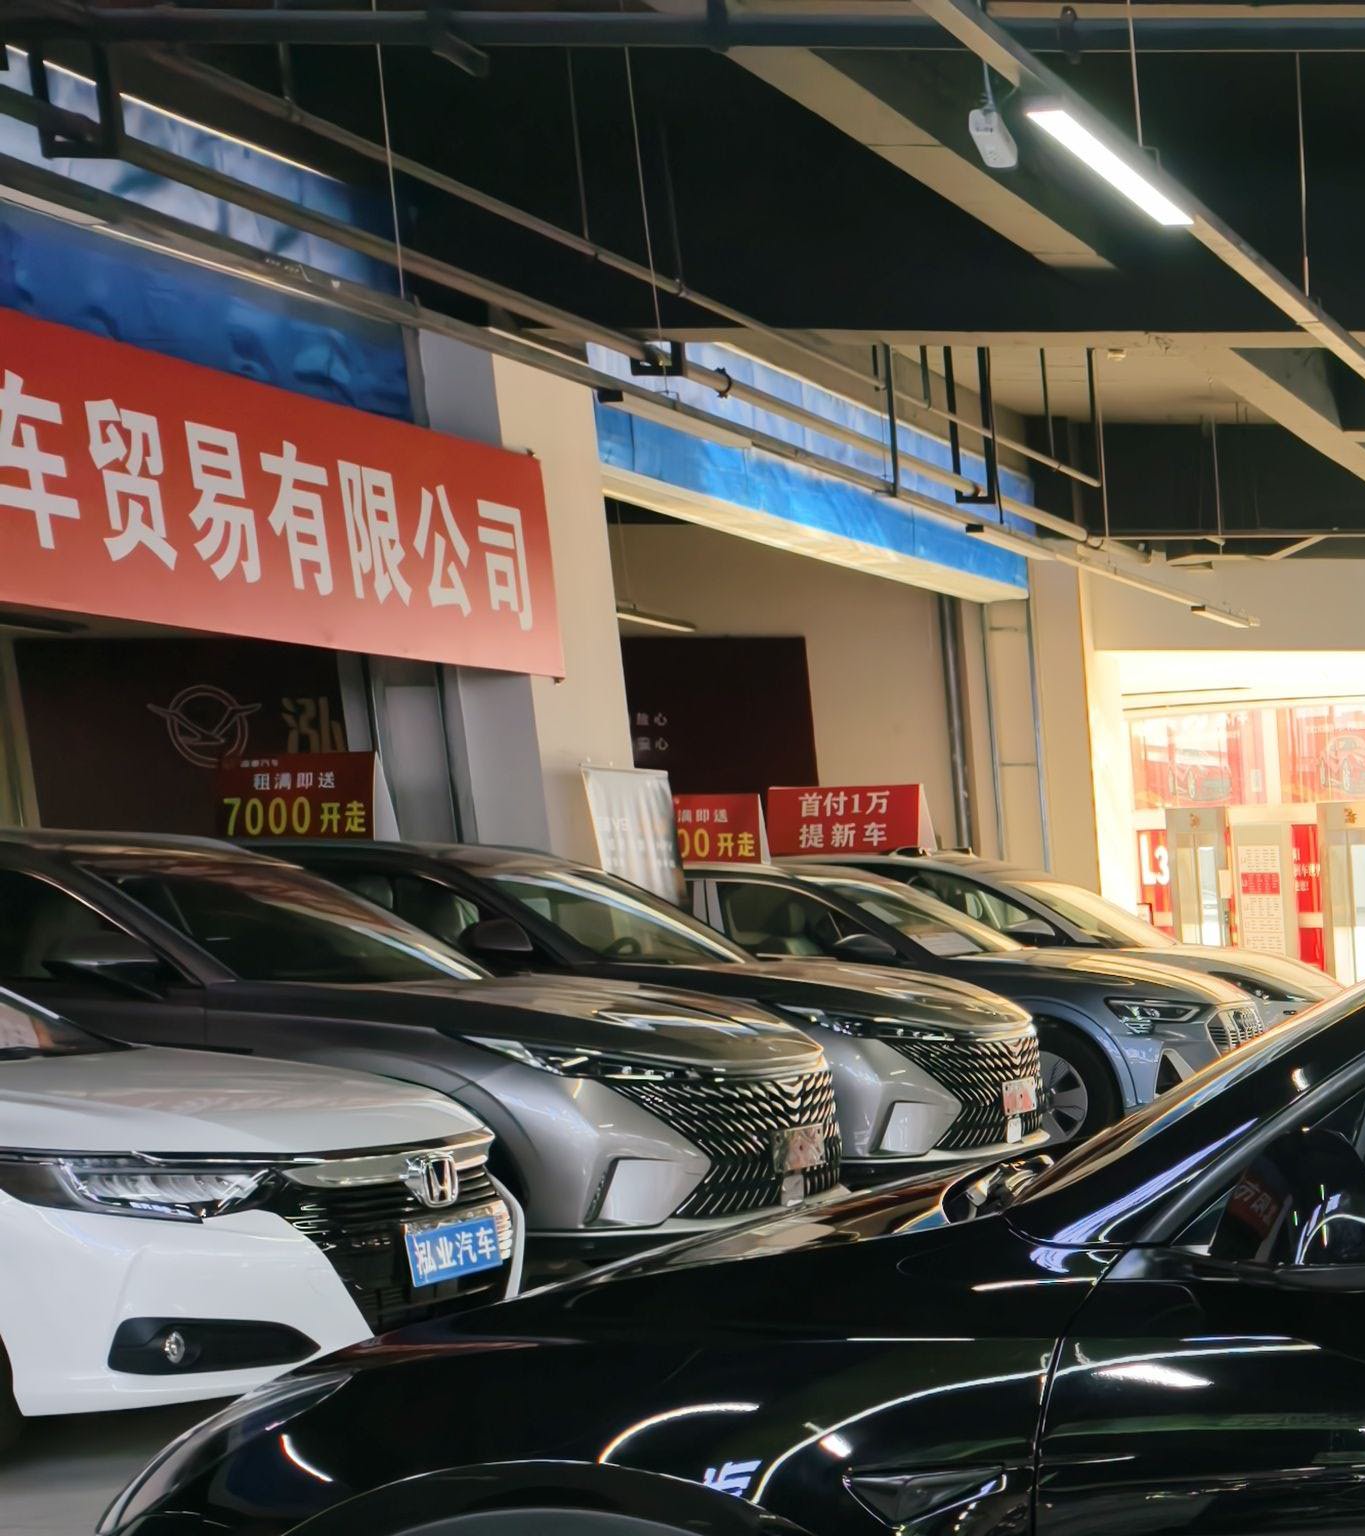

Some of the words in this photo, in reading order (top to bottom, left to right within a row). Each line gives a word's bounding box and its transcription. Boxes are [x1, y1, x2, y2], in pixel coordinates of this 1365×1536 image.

[0, 368, 533, 631] 车贸易有限公司
[253, 771, 336, 791] 租满即送
[798, 790, 890, 818] 首付1万
[799, 822, 888, 849] 提新车
[1139, 833, 1170, 886] L3
